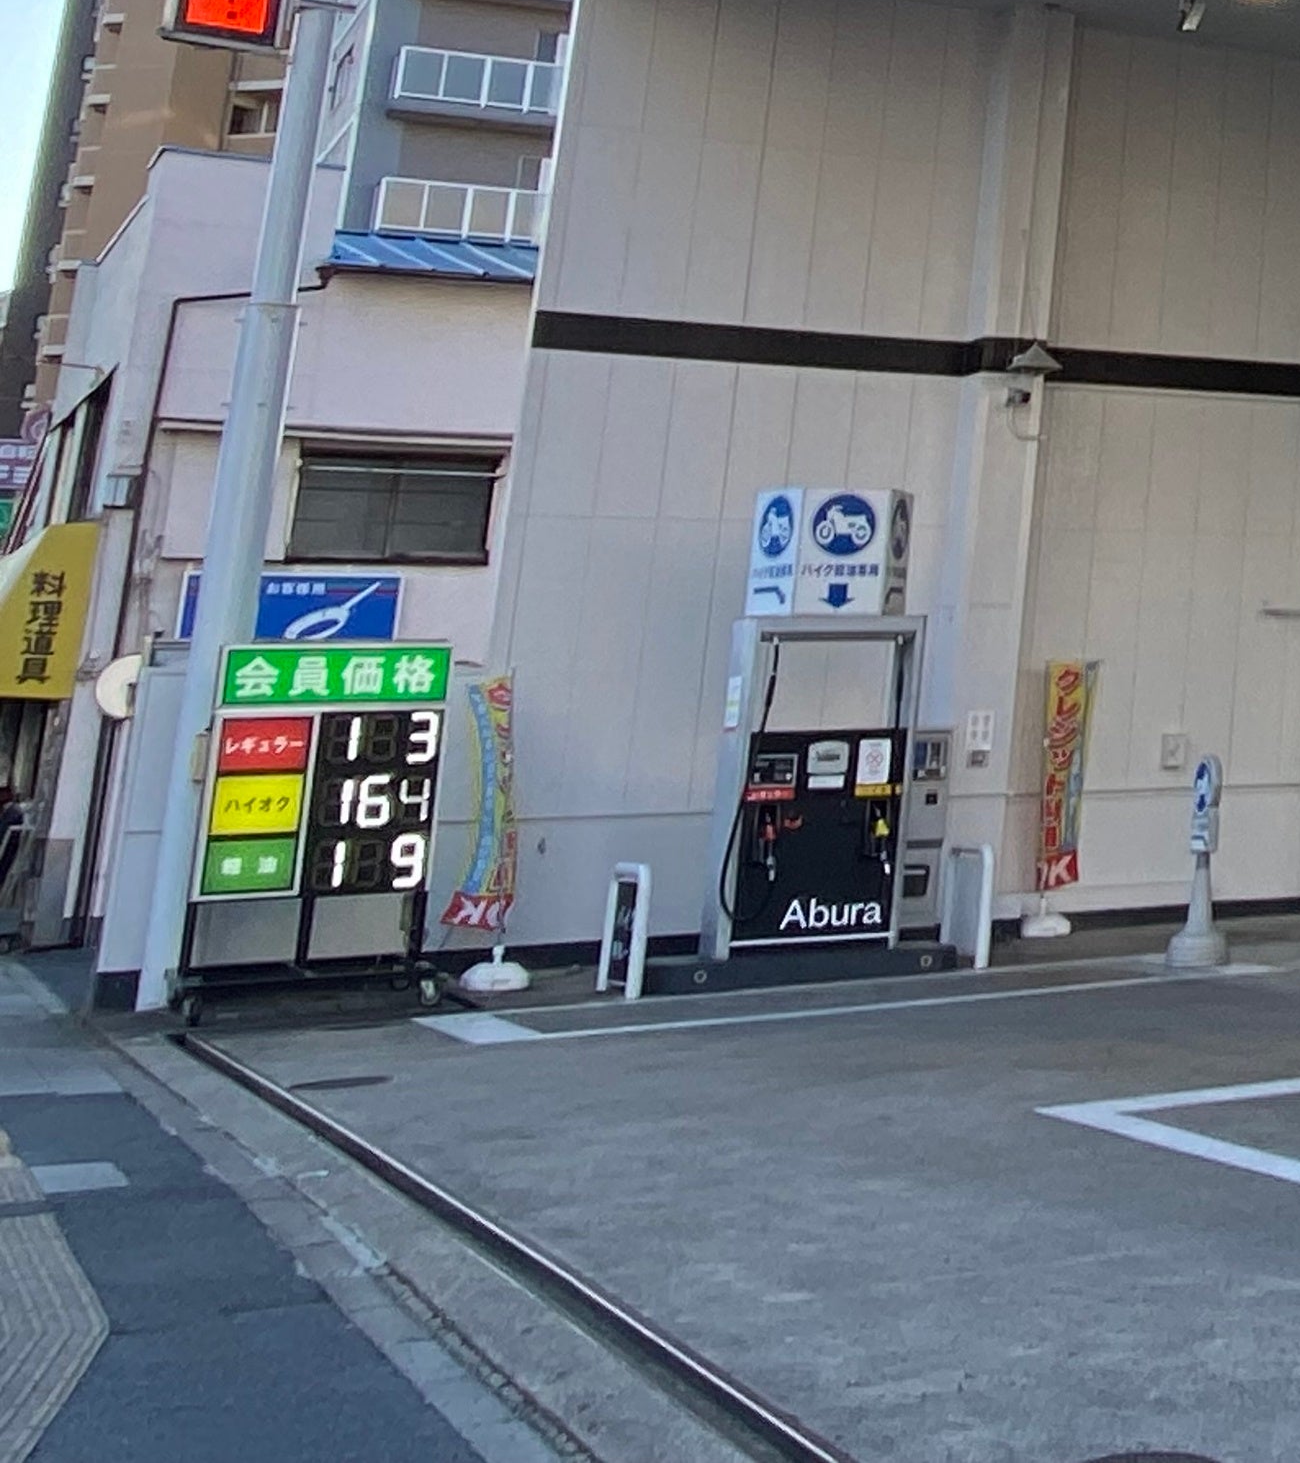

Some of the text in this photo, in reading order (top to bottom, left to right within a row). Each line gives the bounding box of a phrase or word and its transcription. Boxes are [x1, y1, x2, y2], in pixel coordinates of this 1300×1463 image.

[16, 571, 66, 684] 料理道具
[235, 655, 436, 697] 会員価格
[223, 734, 305, 755] レギュラー
[223, 796, 291, 813] ハイオク
[779, 899, 882, 931] Abura
